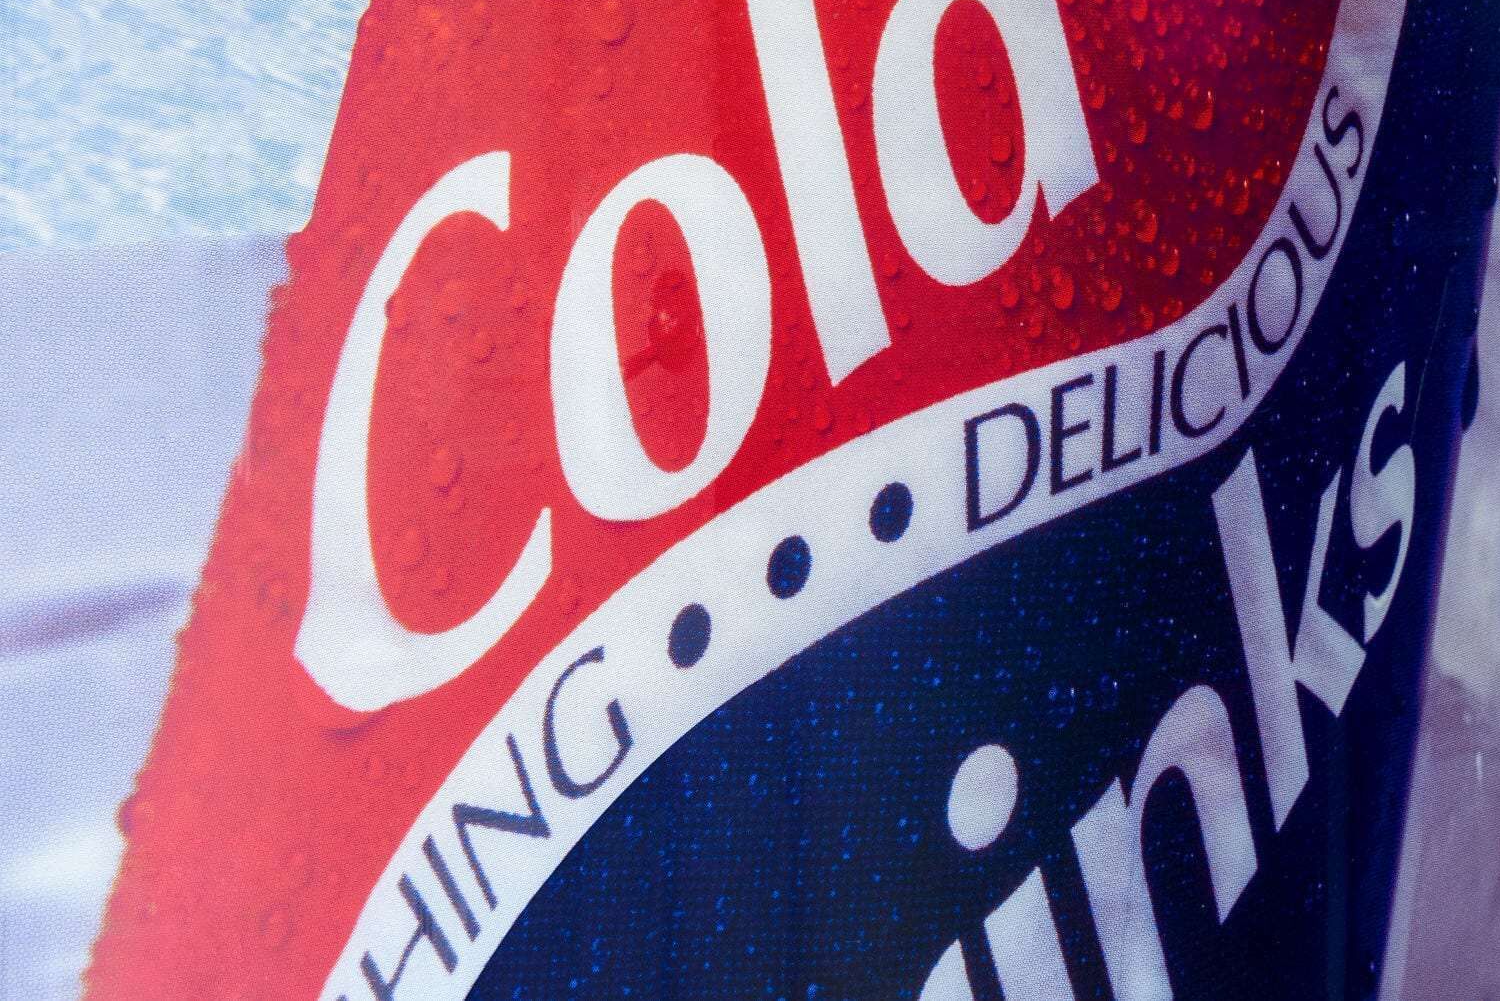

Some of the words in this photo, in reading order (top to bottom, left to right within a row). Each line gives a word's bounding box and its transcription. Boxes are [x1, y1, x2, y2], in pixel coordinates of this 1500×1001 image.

[336, 646, 635, 1001] HING
[963, 85, 1364, 533] DELICIOUS
[918, 360, 1416, 1001] inks
